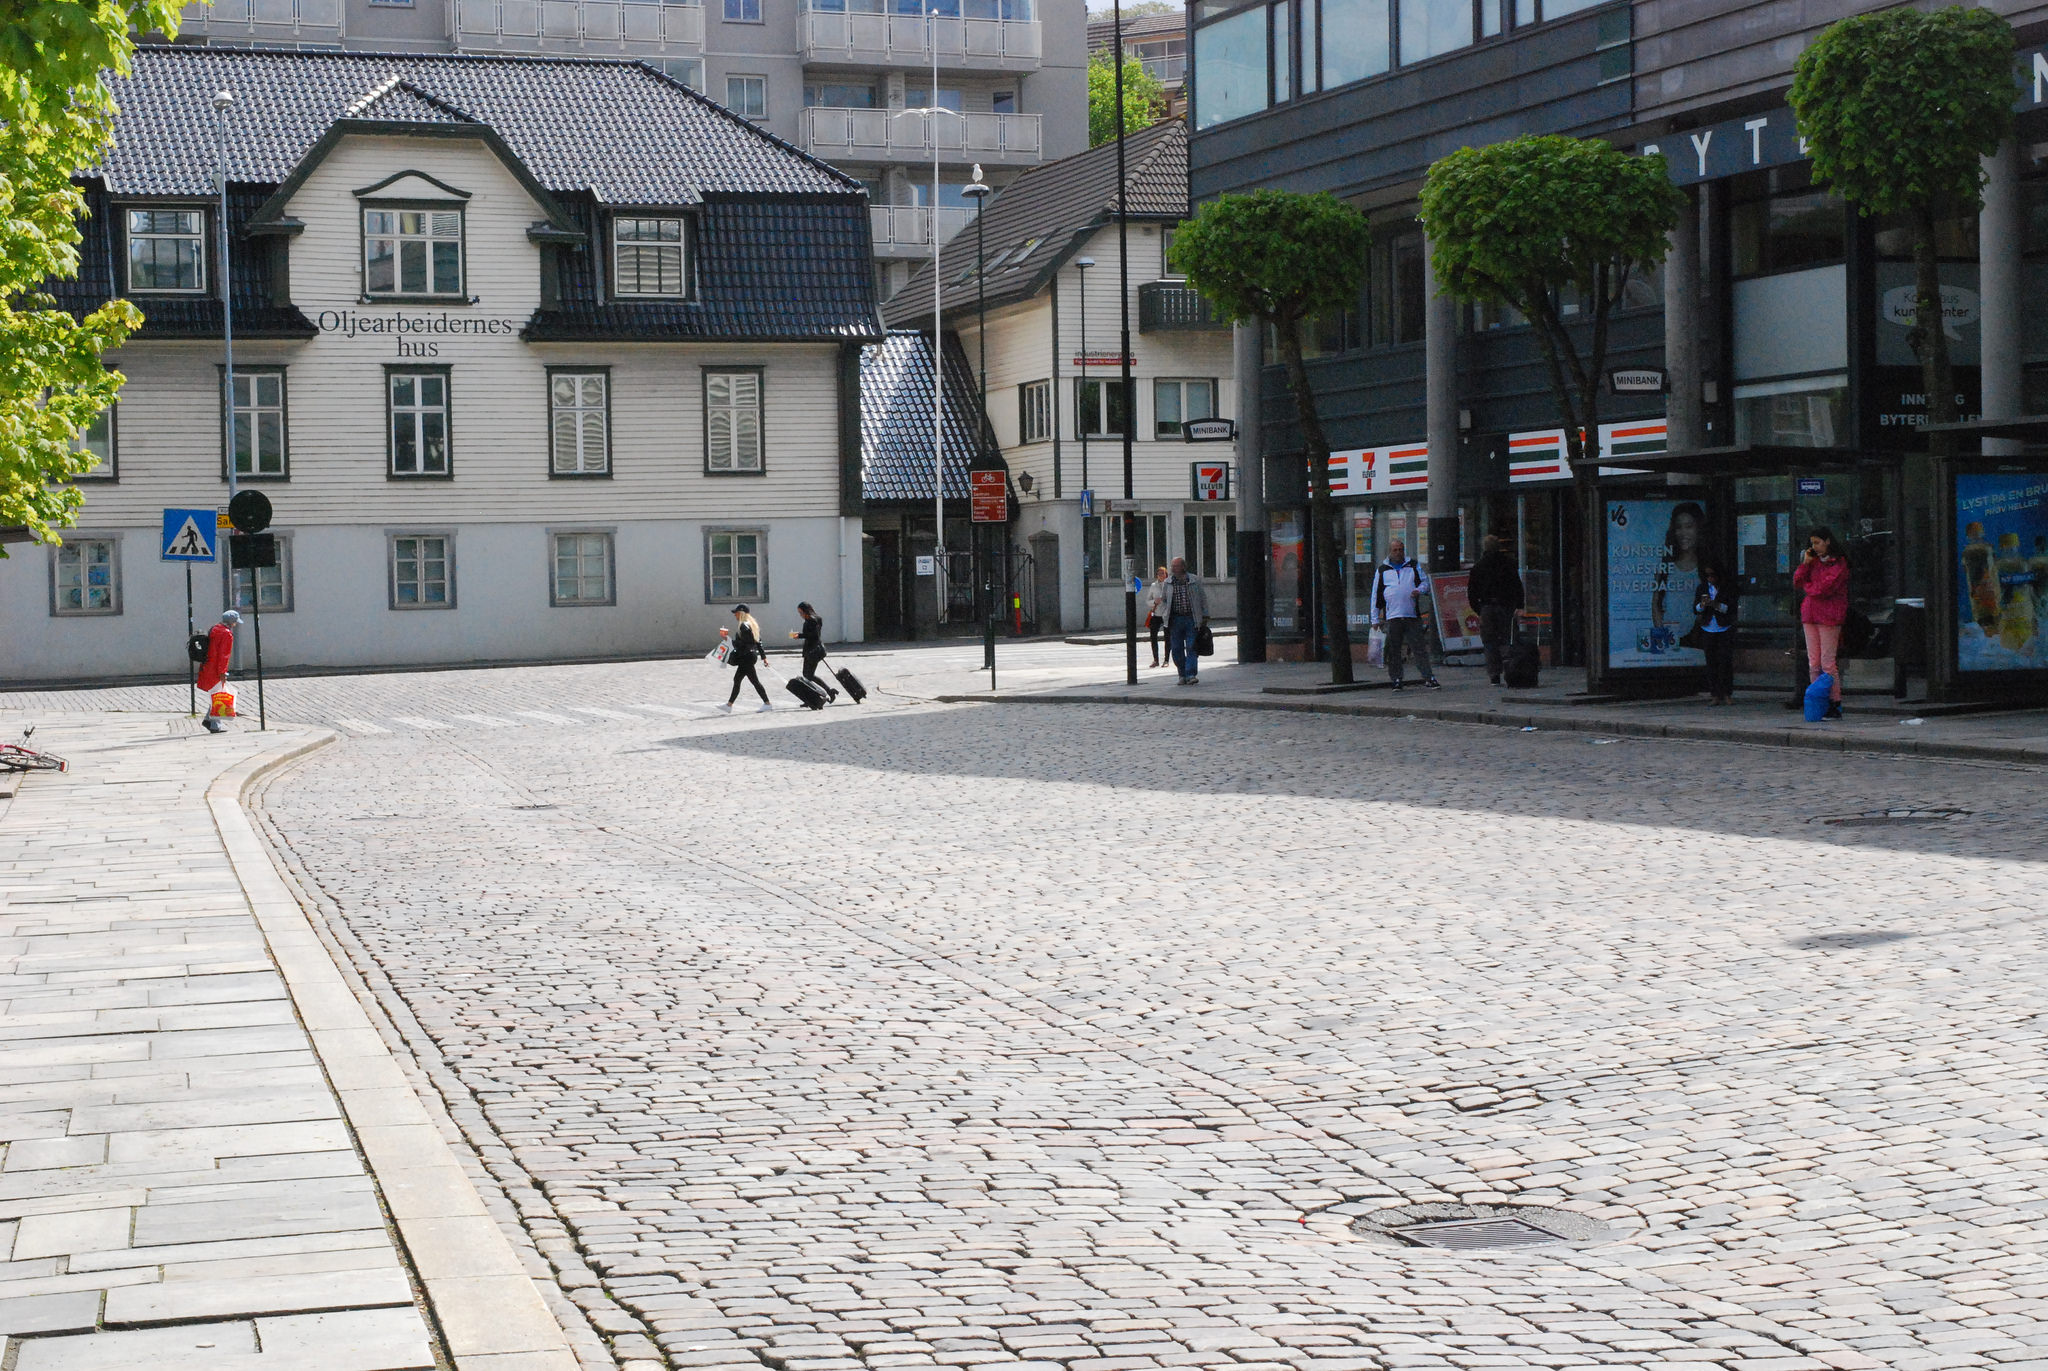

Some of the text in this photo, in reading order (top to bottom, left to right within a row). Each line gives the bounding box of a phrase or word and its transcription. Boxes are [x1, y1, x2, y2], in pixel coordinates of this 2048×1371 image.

[319, 310, 512, 338] Oljearbeidernes
[397, 336, 438, 357] hus
[1616, 376, 1659, 385] MINIBANK
[1901, 394, 1965, 405] INNG
[1193, 426, 1228, 434] MINIBANK
[1613, 545, 1673, 557] KUNSTEN
[1626, 563, 1675, 575] MESTRE
[1612, 580, 1695, 593] HVERDAGEN
